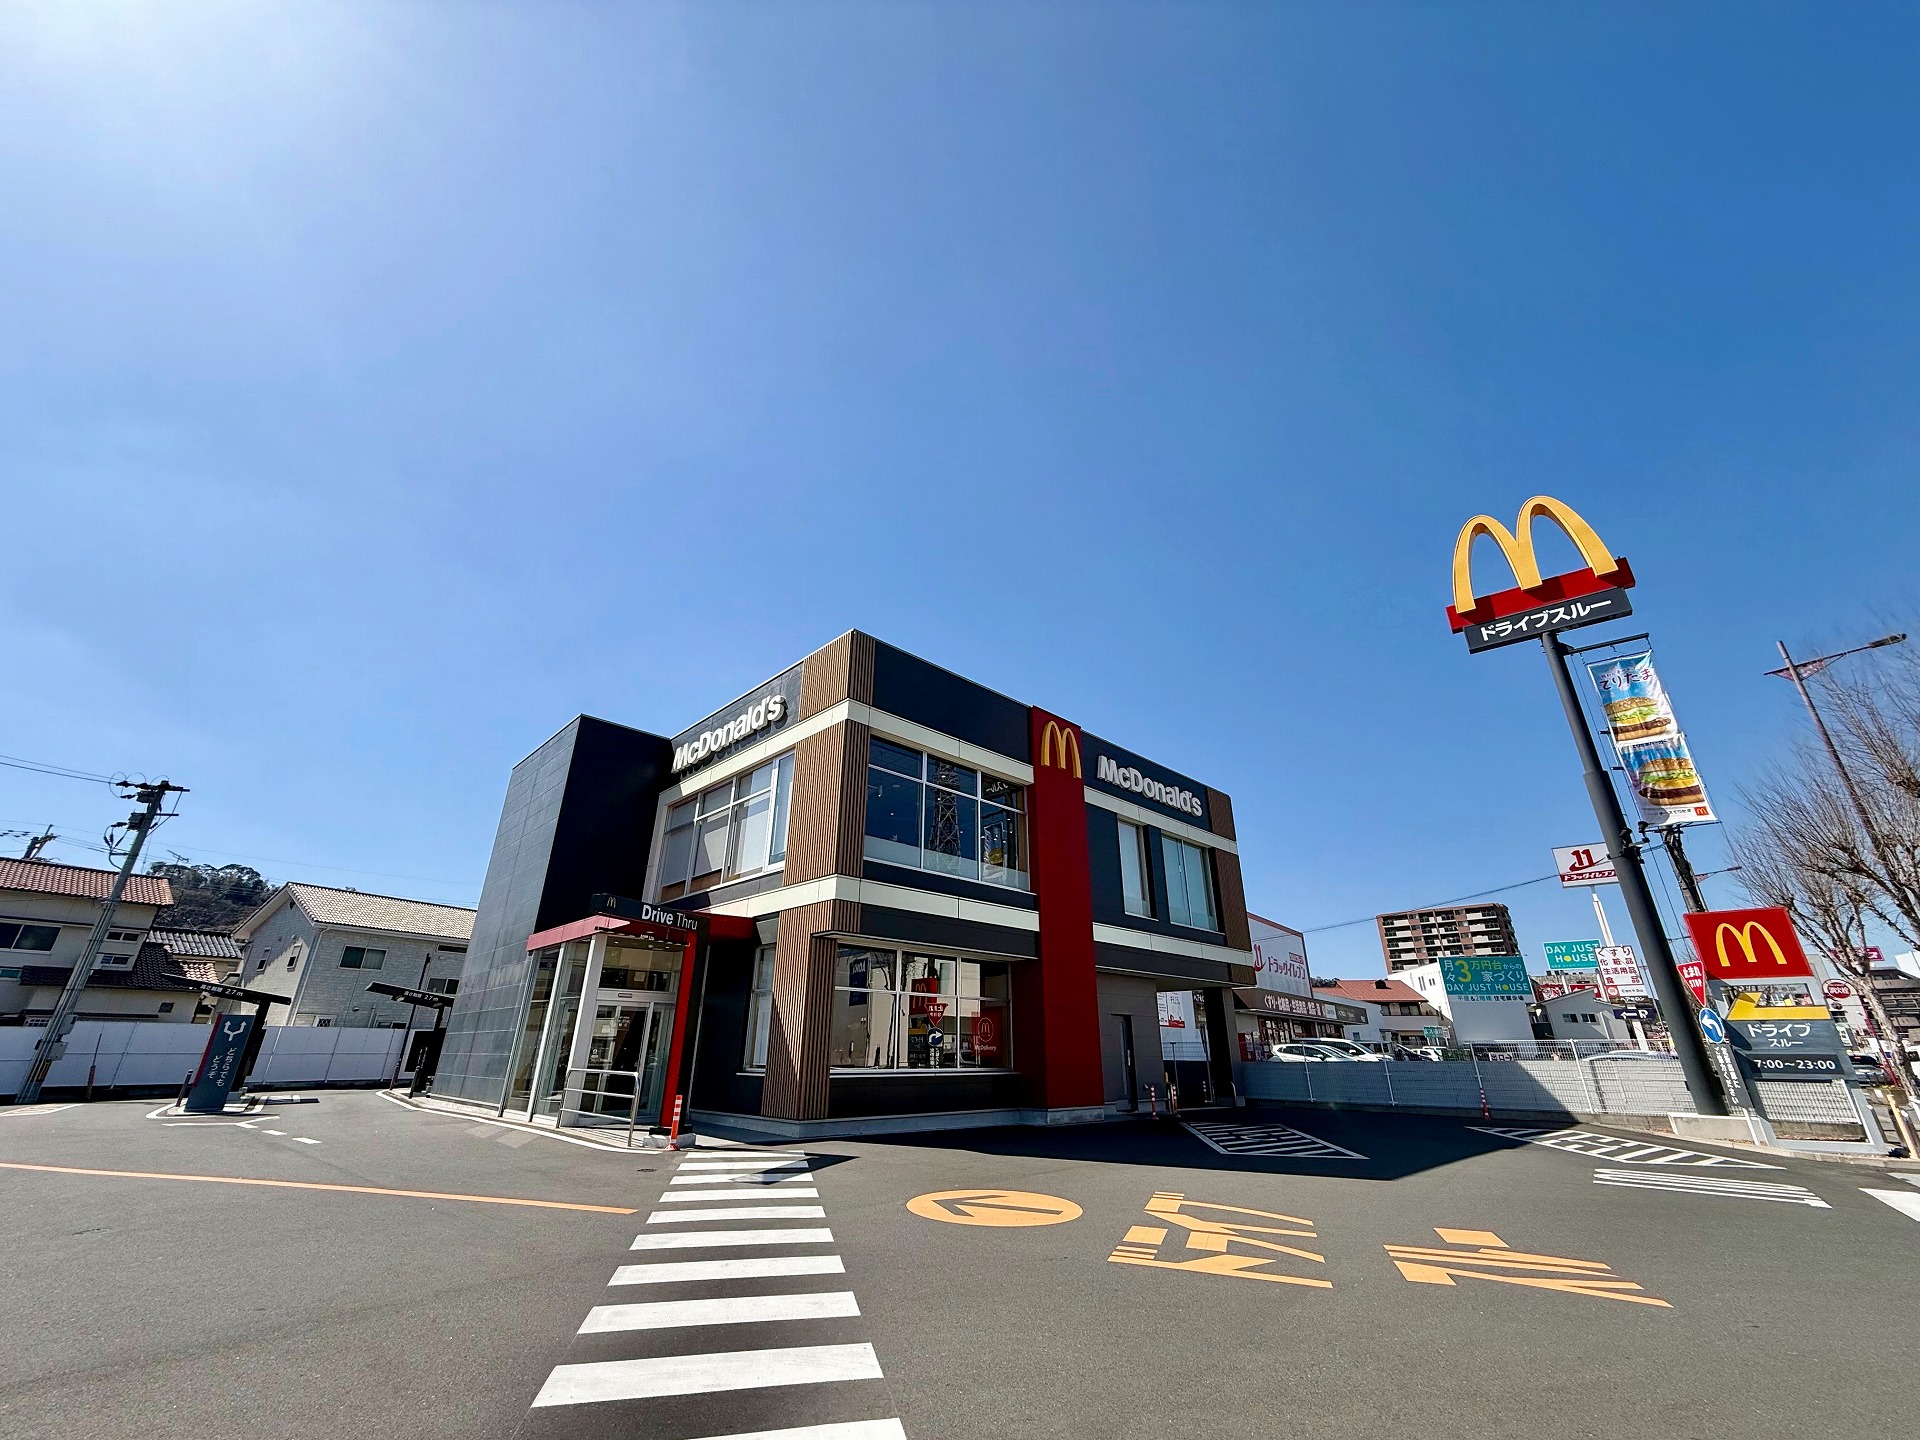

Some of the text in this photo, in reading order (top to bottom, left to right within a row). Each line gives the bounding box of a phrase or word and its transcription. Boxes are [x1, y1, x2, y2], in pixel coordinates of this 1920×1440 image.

[1480, 600, 1612, 641] ドライブスルー
[1599, 668, 1653, 691] てりたま
[671, 695, 784, 773] McDonald's
[1097, 755, 1202, 817] McDonald's
[1564, 870, 1615, 881] ドラッグイレブン
[641, 904, 698, 930] Drive Thru
[1546, 943, 1599, 954] DAY JUST
[1598, 947, 1631, 956] くすり
[1600, 957, 1634, 966] 化粧品
[1481, 971, 1524, 982] 家づくり
[1603, 967, 1638, 975] 生活用品
[1683, 965, 1702, 978] 止まれ
[1446, 984, 1464, 992] DAY
[1689, 979, 1702, 987] STOP
[1747, 1023, 1812, 1038] ドライブ
[1768, 1038, 1804, 1048] スルー
[216, 1047, 238, 1087] どちらでも
